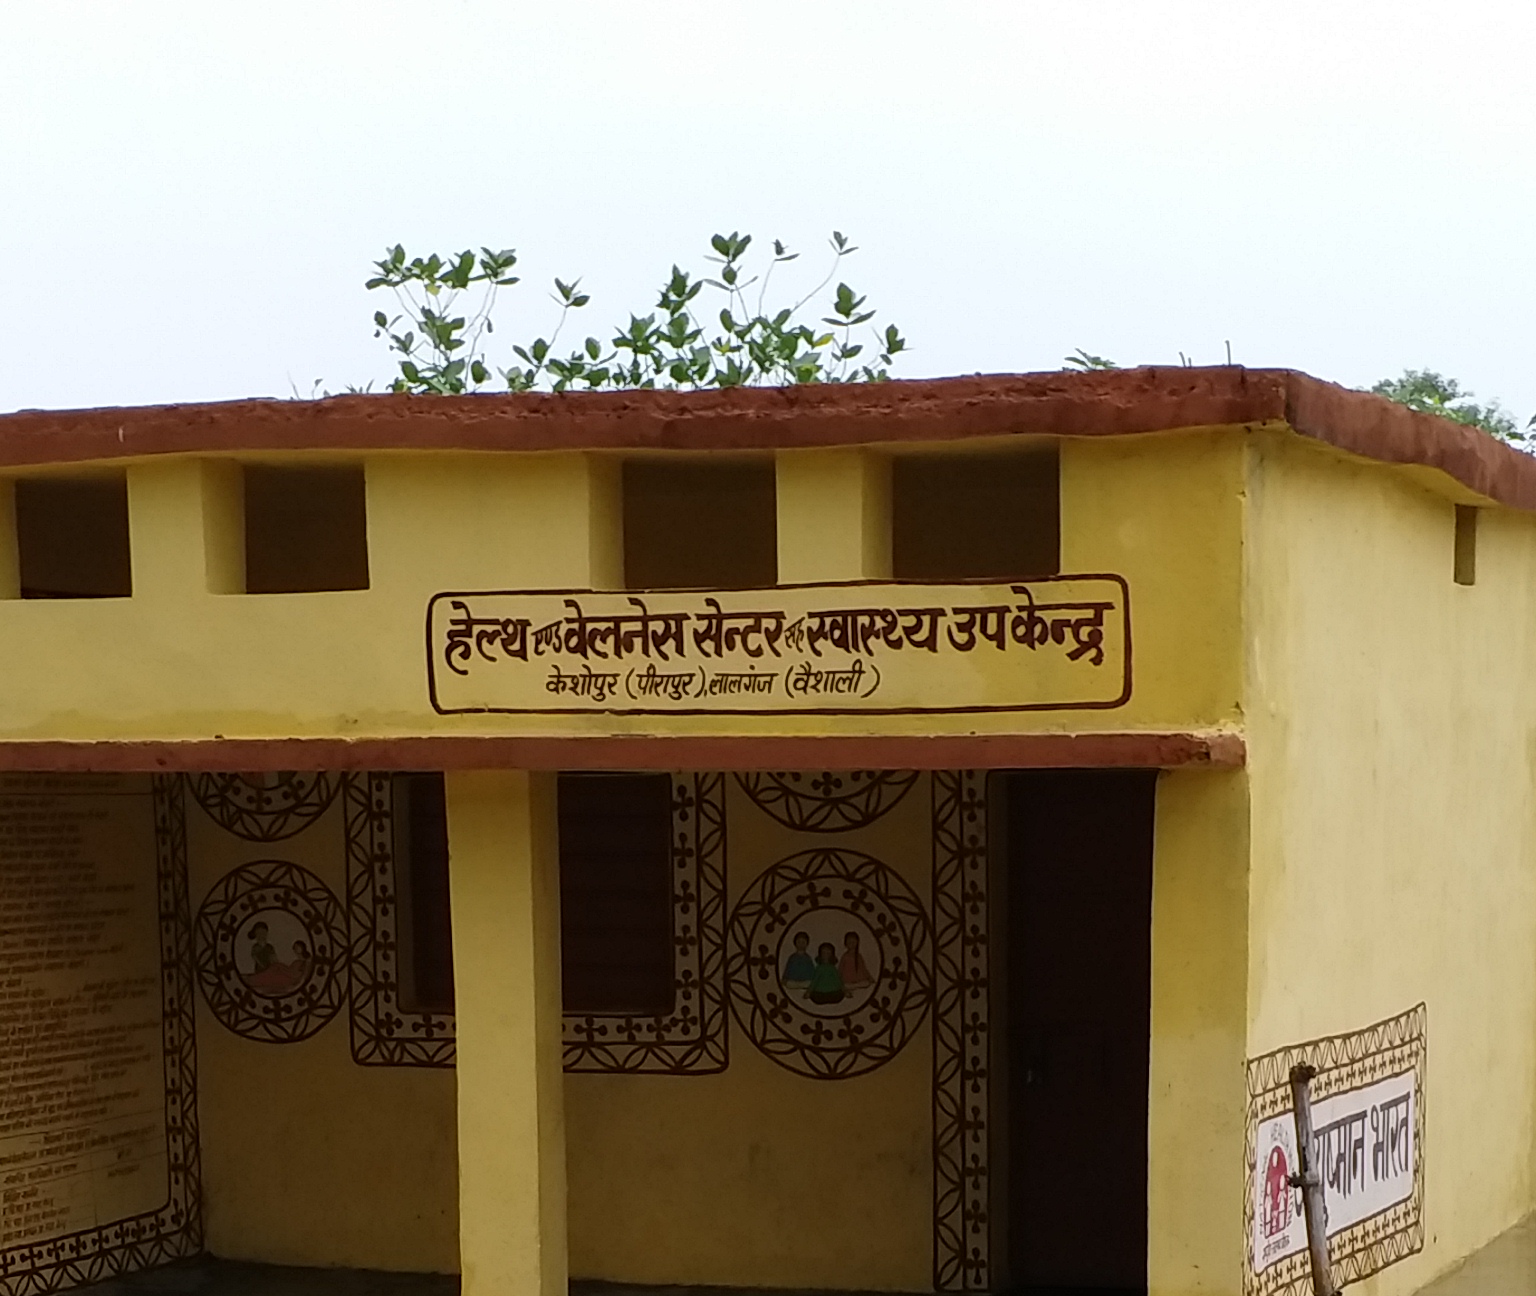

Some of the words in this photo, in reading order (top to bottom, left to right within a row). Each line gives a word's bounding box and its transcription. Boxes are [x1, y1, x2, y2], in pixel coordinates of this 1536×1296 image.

[445, 600, 531, 675] हेल्थ
[564, 599, 691, 661] वेलनेस
[693, 598, 786, 659] सेन्टर
[806, 604, 948, 657] स्वास्थ्य
[546, 664, 620, 702] केशोपुर
[784, 659, 880, 698] (वैशाली)
[1371, 1091, 1411, 1182] भारत
